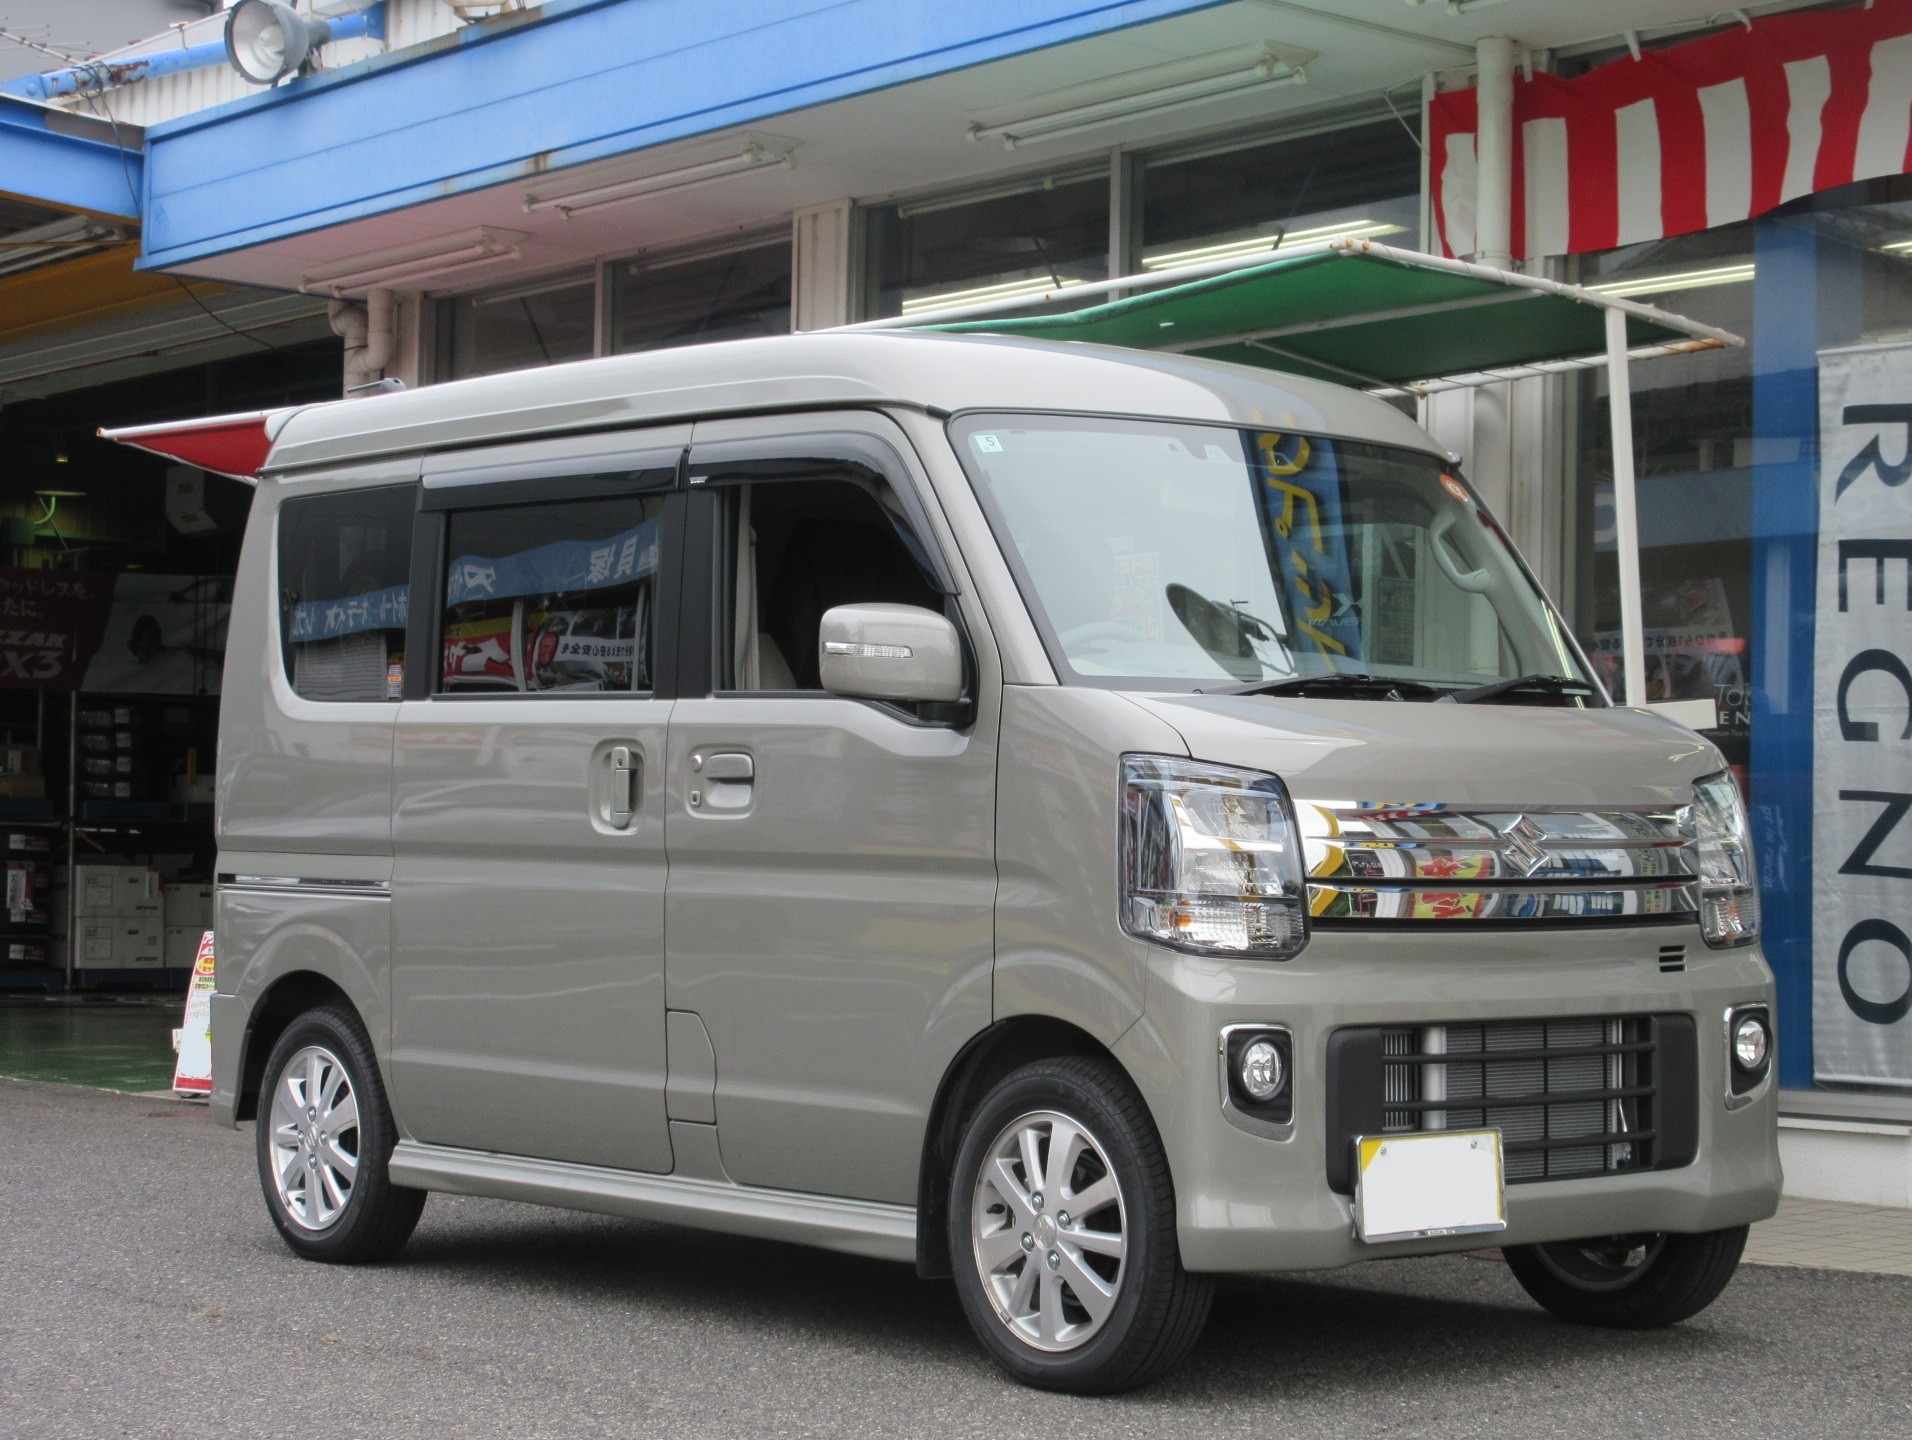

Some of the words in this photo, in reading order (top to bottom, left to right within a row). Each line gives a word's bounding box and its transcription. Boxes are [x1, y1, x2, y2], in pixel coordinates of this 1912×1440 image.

[985, 436, 995, 447] 5
[0, 629, 67, 649] ZAK
[1834, 402, 1912, 1025] REGNO
